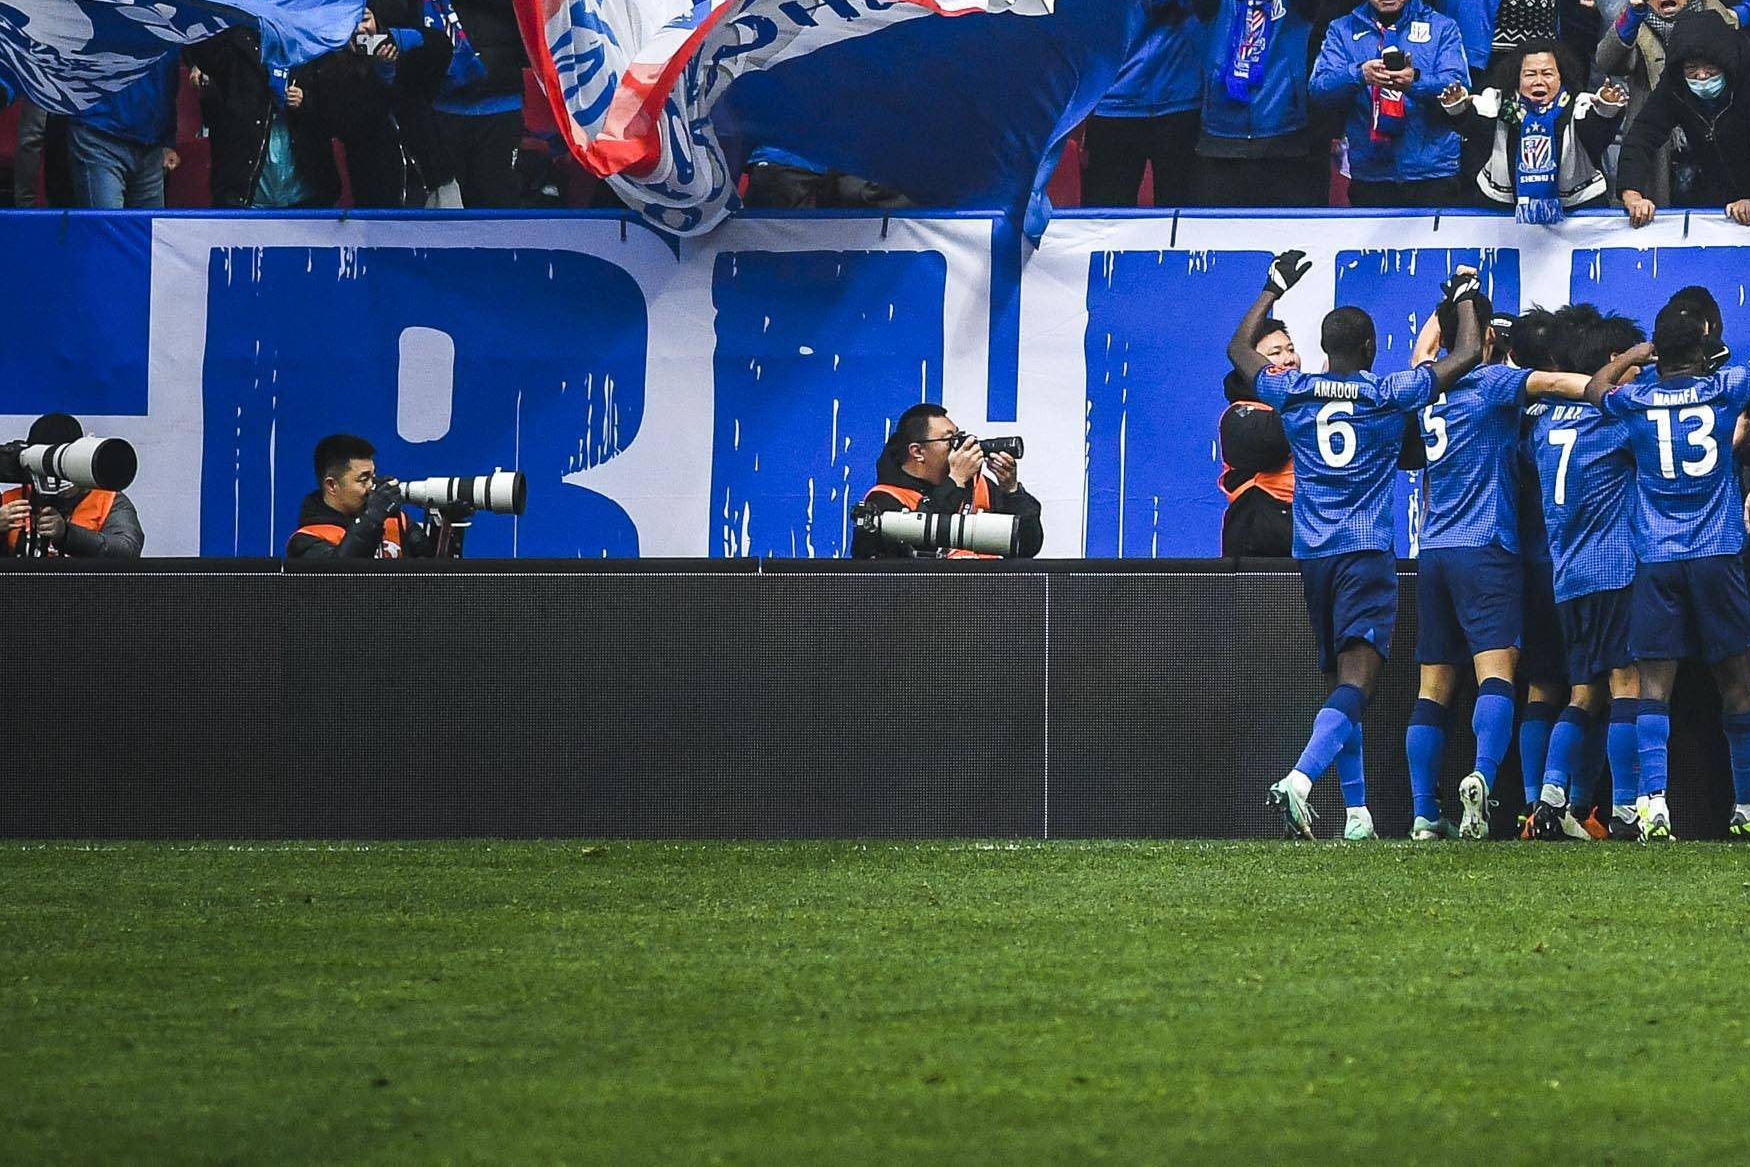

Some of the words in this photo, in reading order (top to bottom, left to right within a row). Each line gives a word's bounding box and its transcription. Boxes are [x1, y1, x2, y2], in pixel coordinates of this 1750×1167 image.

[1314, 381, 1359, 399] AMADOU
[1653, 386, 1700, 406] MANAFA
[1316, 401, 1356, 468] 6
[1423, 392, 1448, 462] 5
[1647, 404, 1719, 479] 13
[1547, 428, 1578, 505] 7
